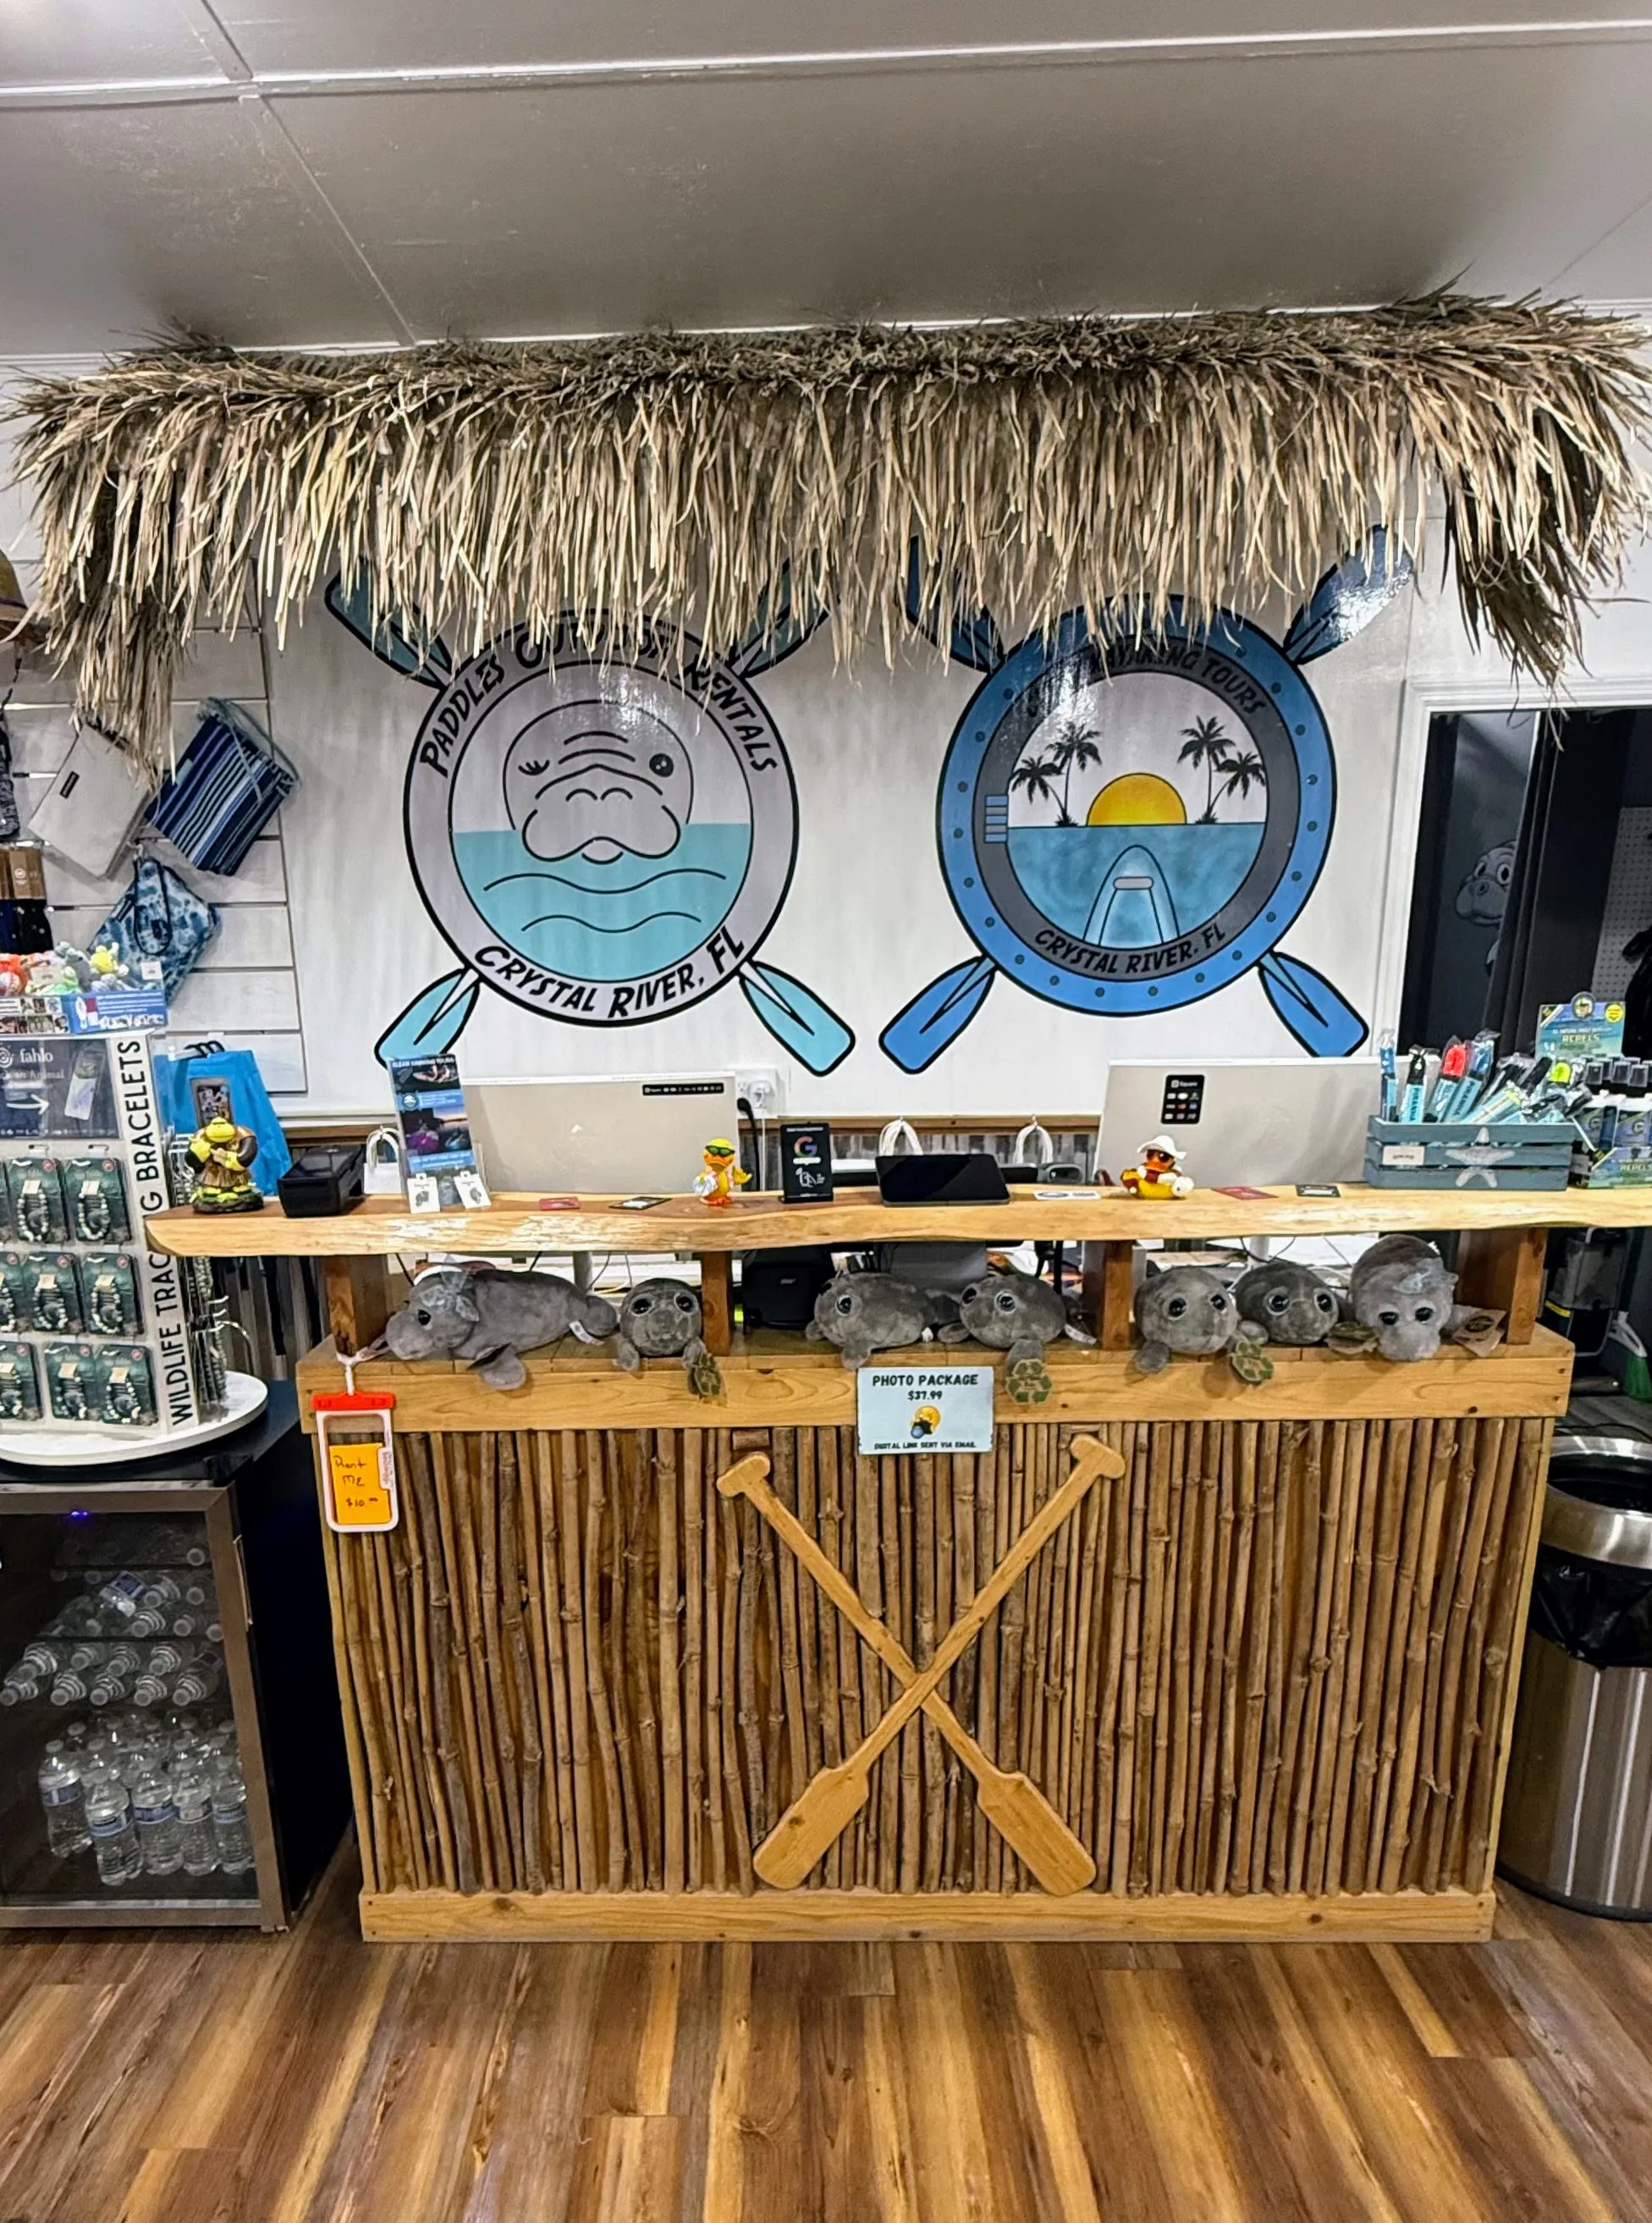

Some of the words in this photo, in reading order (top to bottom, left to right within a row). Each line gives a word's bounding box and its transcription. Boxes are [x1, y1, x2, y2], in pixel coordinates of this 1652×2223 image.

[1201, 657, 1266, 714] TOURS
[420, 653, 504, 778] PADDLES
[675, 654, 778, 771] RENTALS
[475, 946, 595, 1012] CRYSTAL
[608, 963, 704, 1018] RIVER,
[707, 925, 745, 975] FL
[1034, 929, 1118, 973] CRYSTAL
[1202, 923, 1225, 948] FL
[20, 1048, 53, 1062] fahlo
[118, 1041, 159, 1181] BRACELETS
[159, 1323, 194, 1426] WILDLIFE
[873, 1375, 914, 1387] PHOTO
[918, 1374, 979, 1386] PACKAGE
[907, 1390, 943, 1401] $37.99
